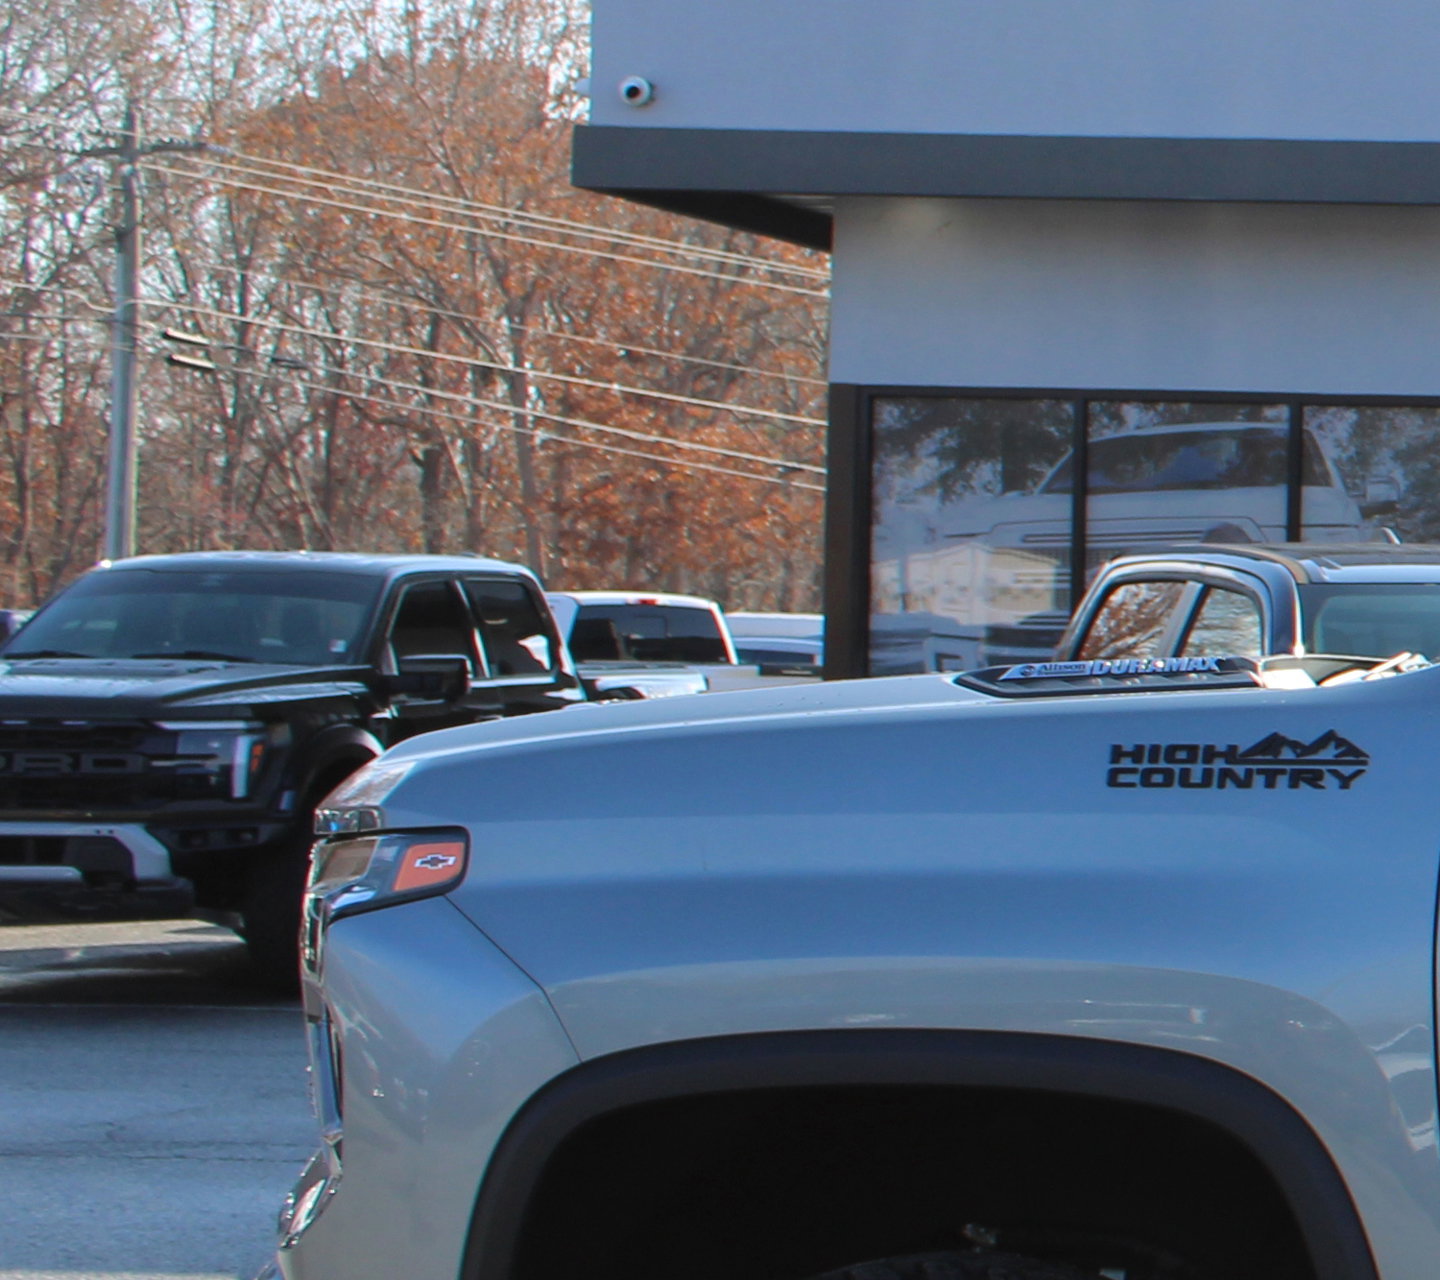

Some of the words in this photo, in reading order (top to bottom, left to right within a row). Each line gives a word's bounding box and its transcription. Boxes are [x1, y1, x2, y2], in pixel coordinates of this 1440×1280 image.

[1040, 662, 1087, 672] Allison
[1091, 656, 1220, 675] DURAMAX
[1109, 743, 1240, 765] HIGH
[1106, 767, 1366, 789] COUNTRY
